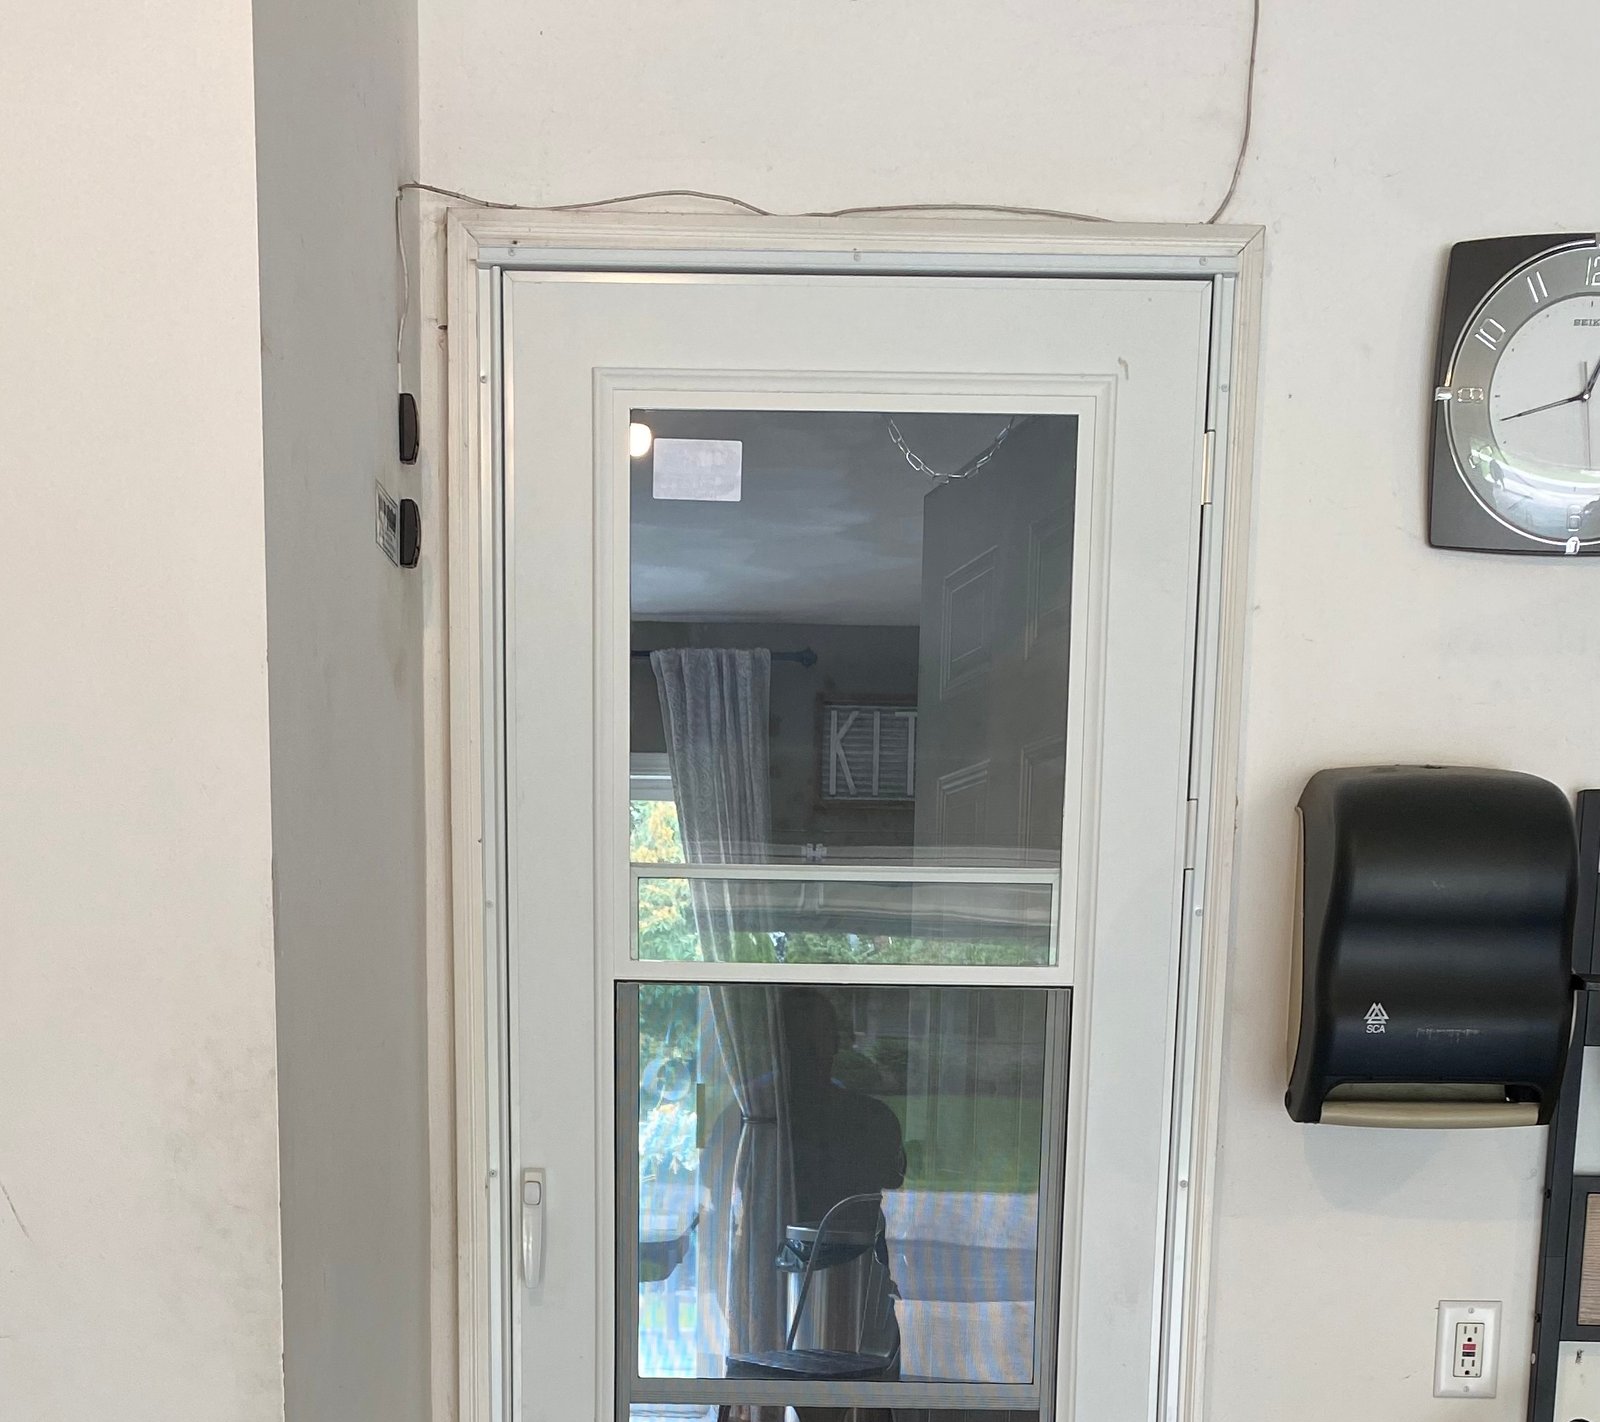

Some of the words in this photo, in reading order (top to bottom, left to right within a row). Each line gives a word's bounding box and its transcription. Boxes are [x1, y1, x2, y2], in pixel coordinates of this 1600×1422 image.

[1526, 271, 1548, 302] 11
[1474, 318, 1506, 350] 10
[1365, 1024, 1386, 1034] SCA
